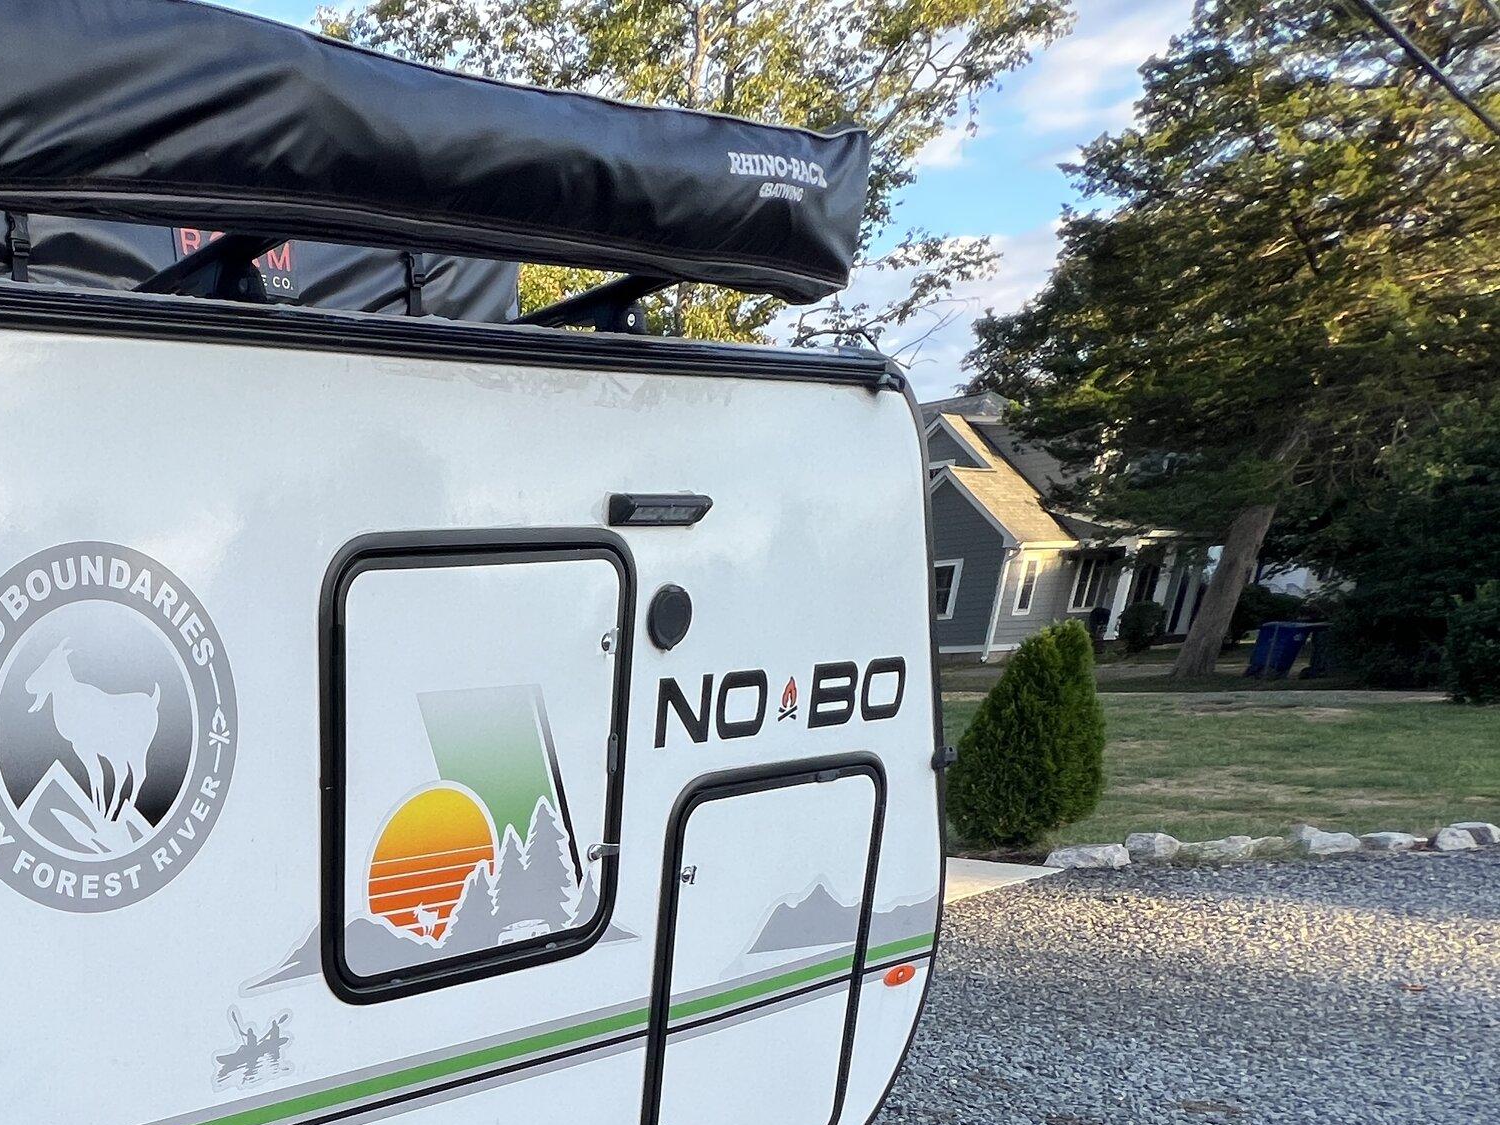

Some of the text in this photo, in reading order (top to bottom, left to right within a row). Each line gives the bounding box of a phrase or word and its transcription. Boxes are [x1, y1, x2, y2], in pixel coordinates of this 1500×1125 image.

[272, 276, 294, 290] CO.
[0, 556, 214, 666] BOUNDARIES
[654, 656, 906, 748] NO BO
[13, 850, 141, 899] FOREST
[151, 775, 221, 872] RIVER
